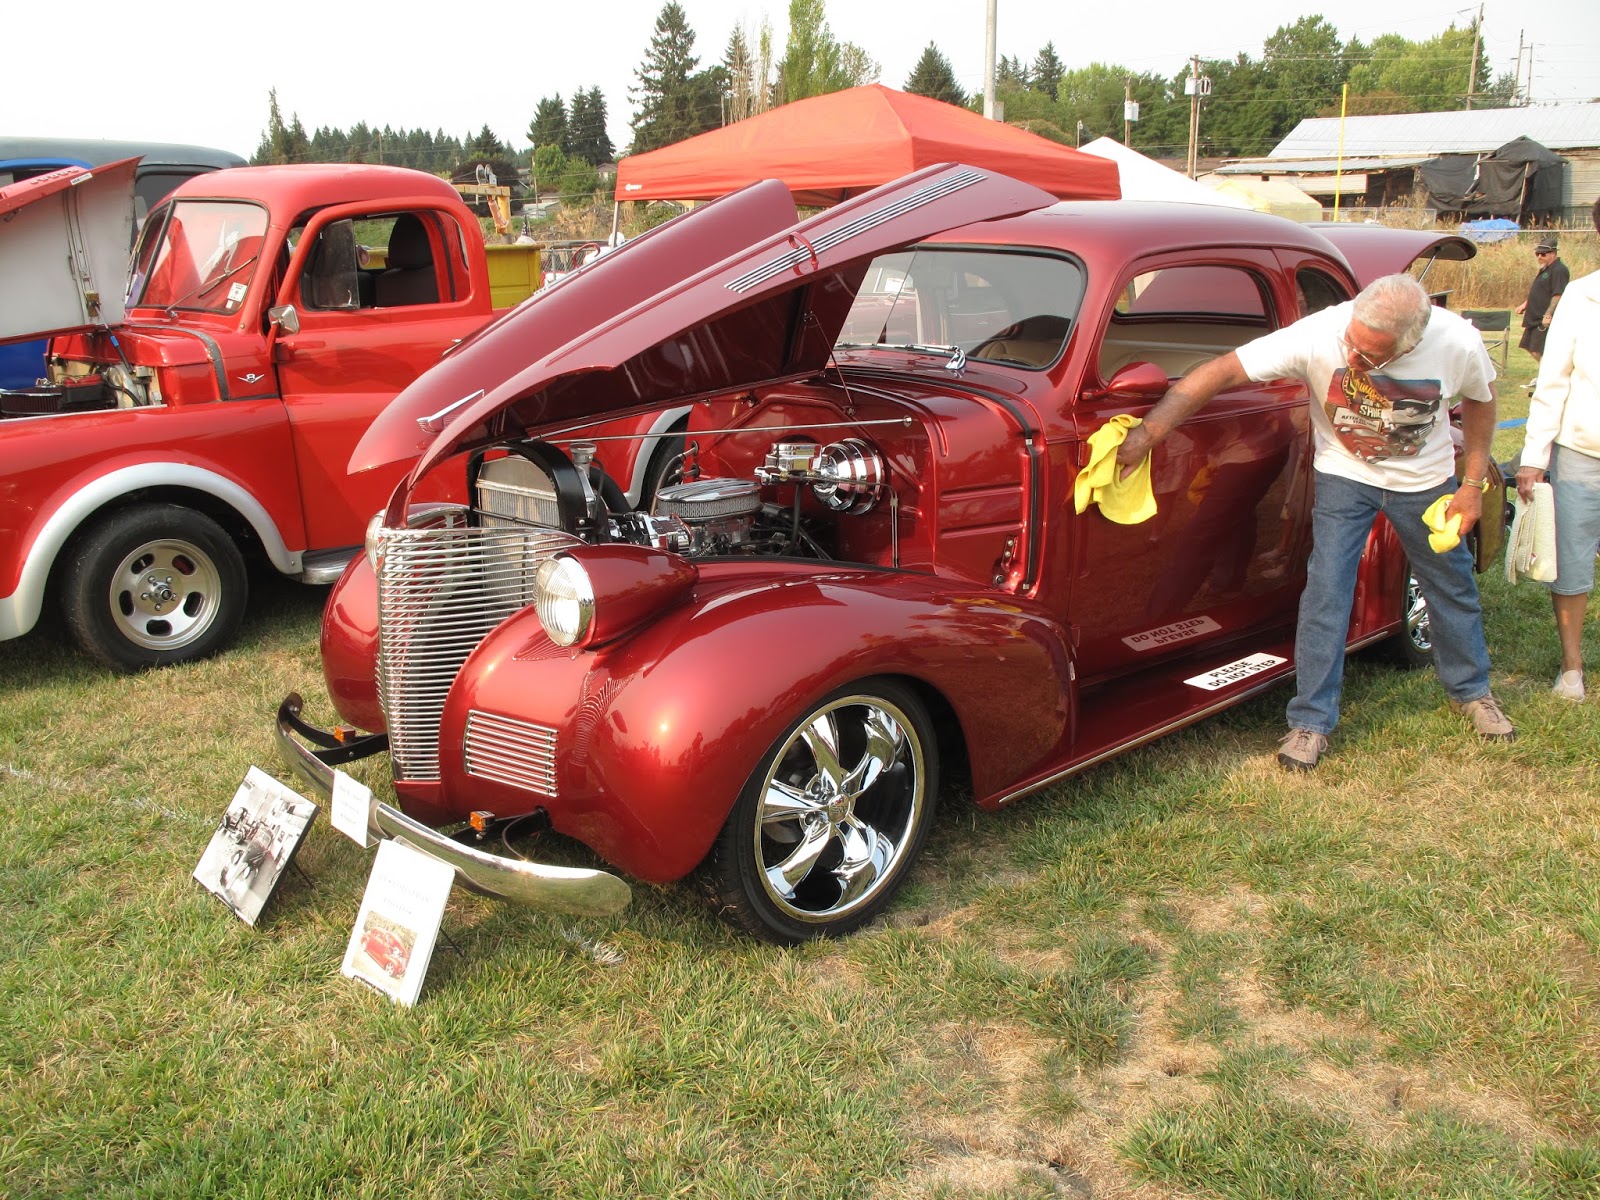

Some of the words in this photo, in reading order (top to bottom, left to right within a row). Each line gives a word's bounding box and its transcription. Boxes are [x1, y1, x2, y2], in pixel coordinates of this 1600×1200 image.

[1208, 679, 1228, 687] DO
[1226, 669, 1251, 680] NOT
[1249, 659, 1276, 671] STEP
[1209, 661, 1253, 677] PLEASE
